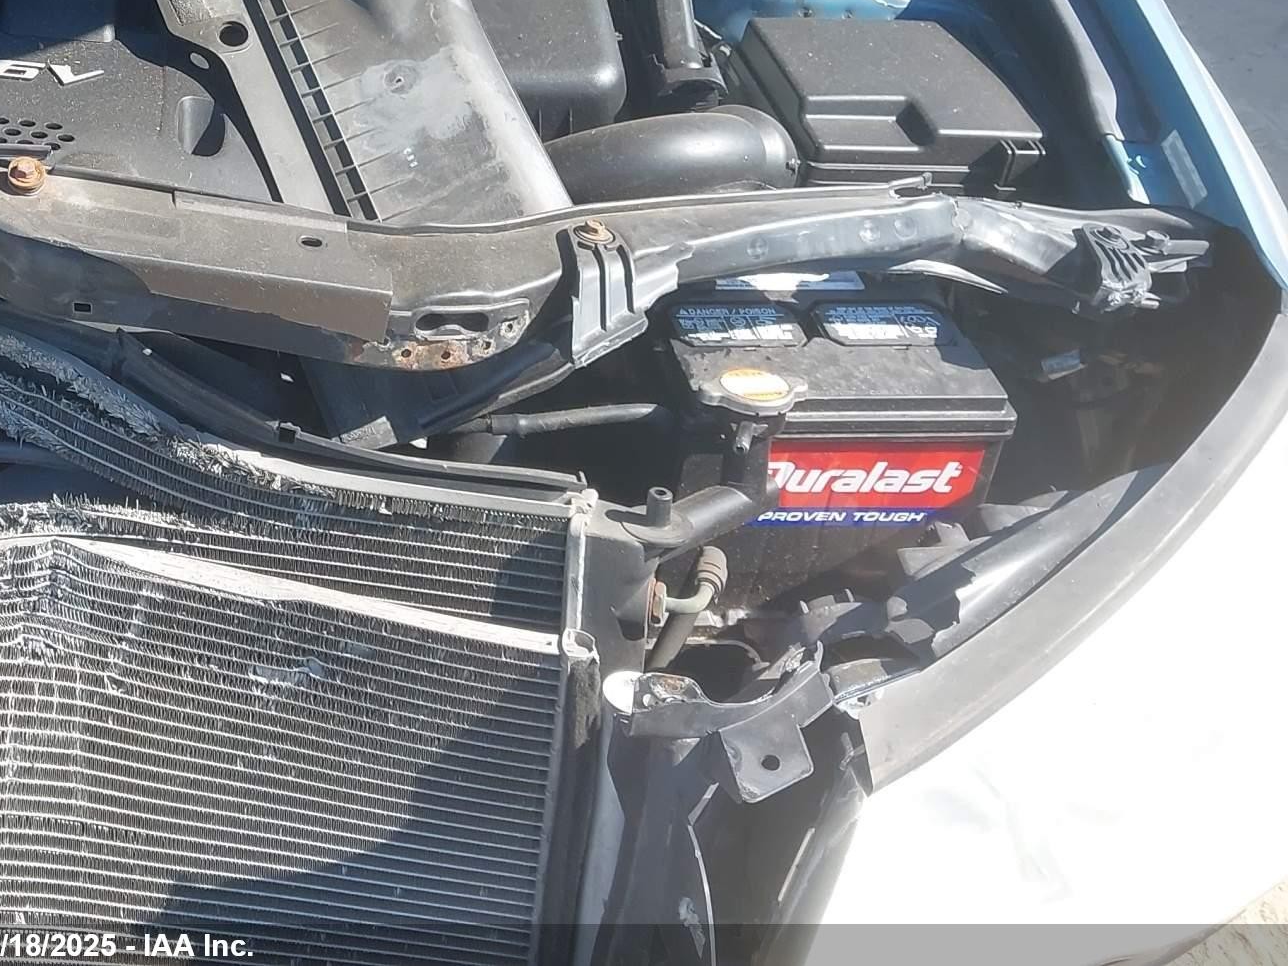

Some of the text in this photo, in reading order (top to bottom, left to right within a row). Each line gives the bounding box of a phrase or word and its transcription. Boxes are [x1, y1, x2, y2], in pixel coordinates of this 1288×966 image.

[688, 307, 729, 315] DANGER
[739, 307, 776, 315] POISON
[758, 511, 925, 522] PROVEN TOUGH
